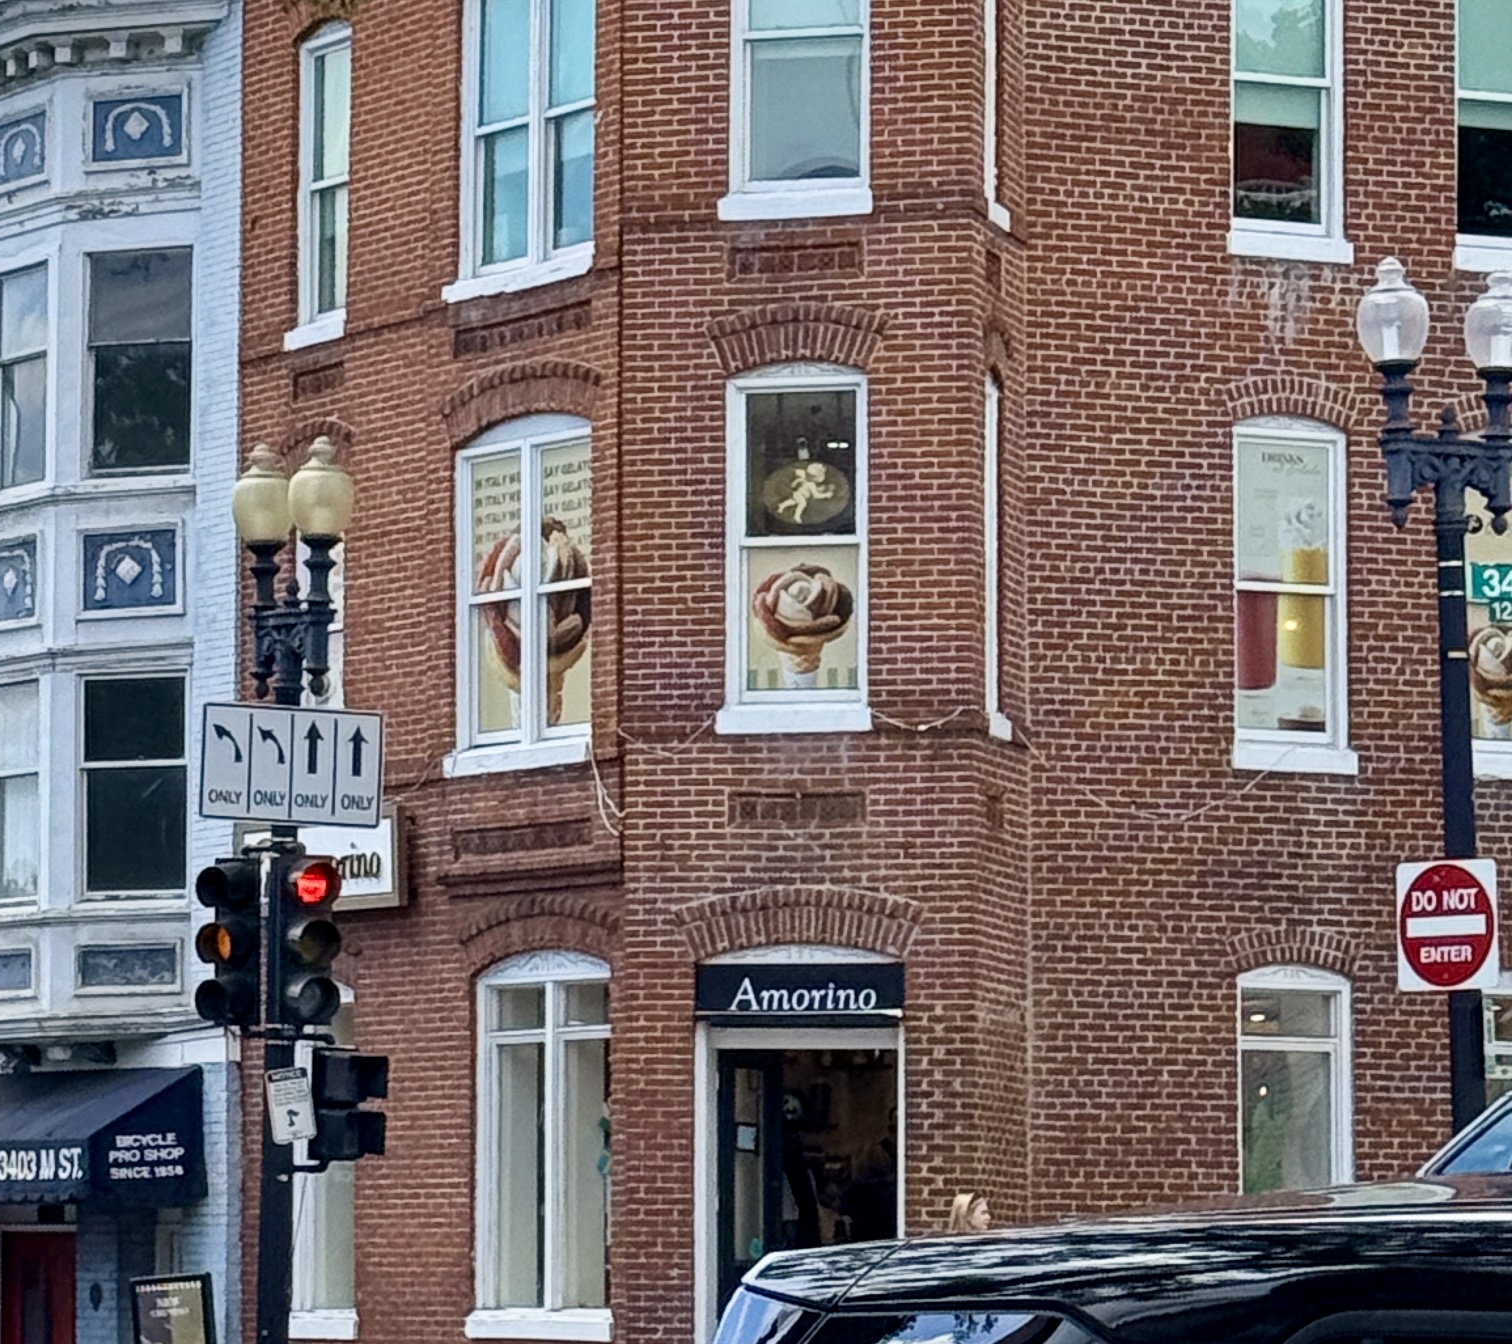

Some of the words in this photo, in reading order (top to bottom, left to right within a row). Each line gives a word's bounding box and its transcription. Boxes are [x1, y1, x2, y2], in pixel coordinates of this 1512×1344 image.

[208, 789, 242, 804] ONLY
[253, 789, 286, 806] ONLY
[294, 793, 329, 808] ONLY
[340, 794, 375, 810] ONLY
[337, 842, 381, 879] rino
[1411, 890, 1436, 912] DO
[1442, 888, 1479, 910] NOT
[1420, 945, 1472, 963] ENTER
[728, 977, 877, 1010] Amorino
[115, 1132, 177, 1147] BICYCLE
[39, 1149, 56, 1180] M
[58, 1148, 83, 1181] ST.
[109, 1150, 140, 1164] PRO
[143, 1147, 184, 1162] SHOP
